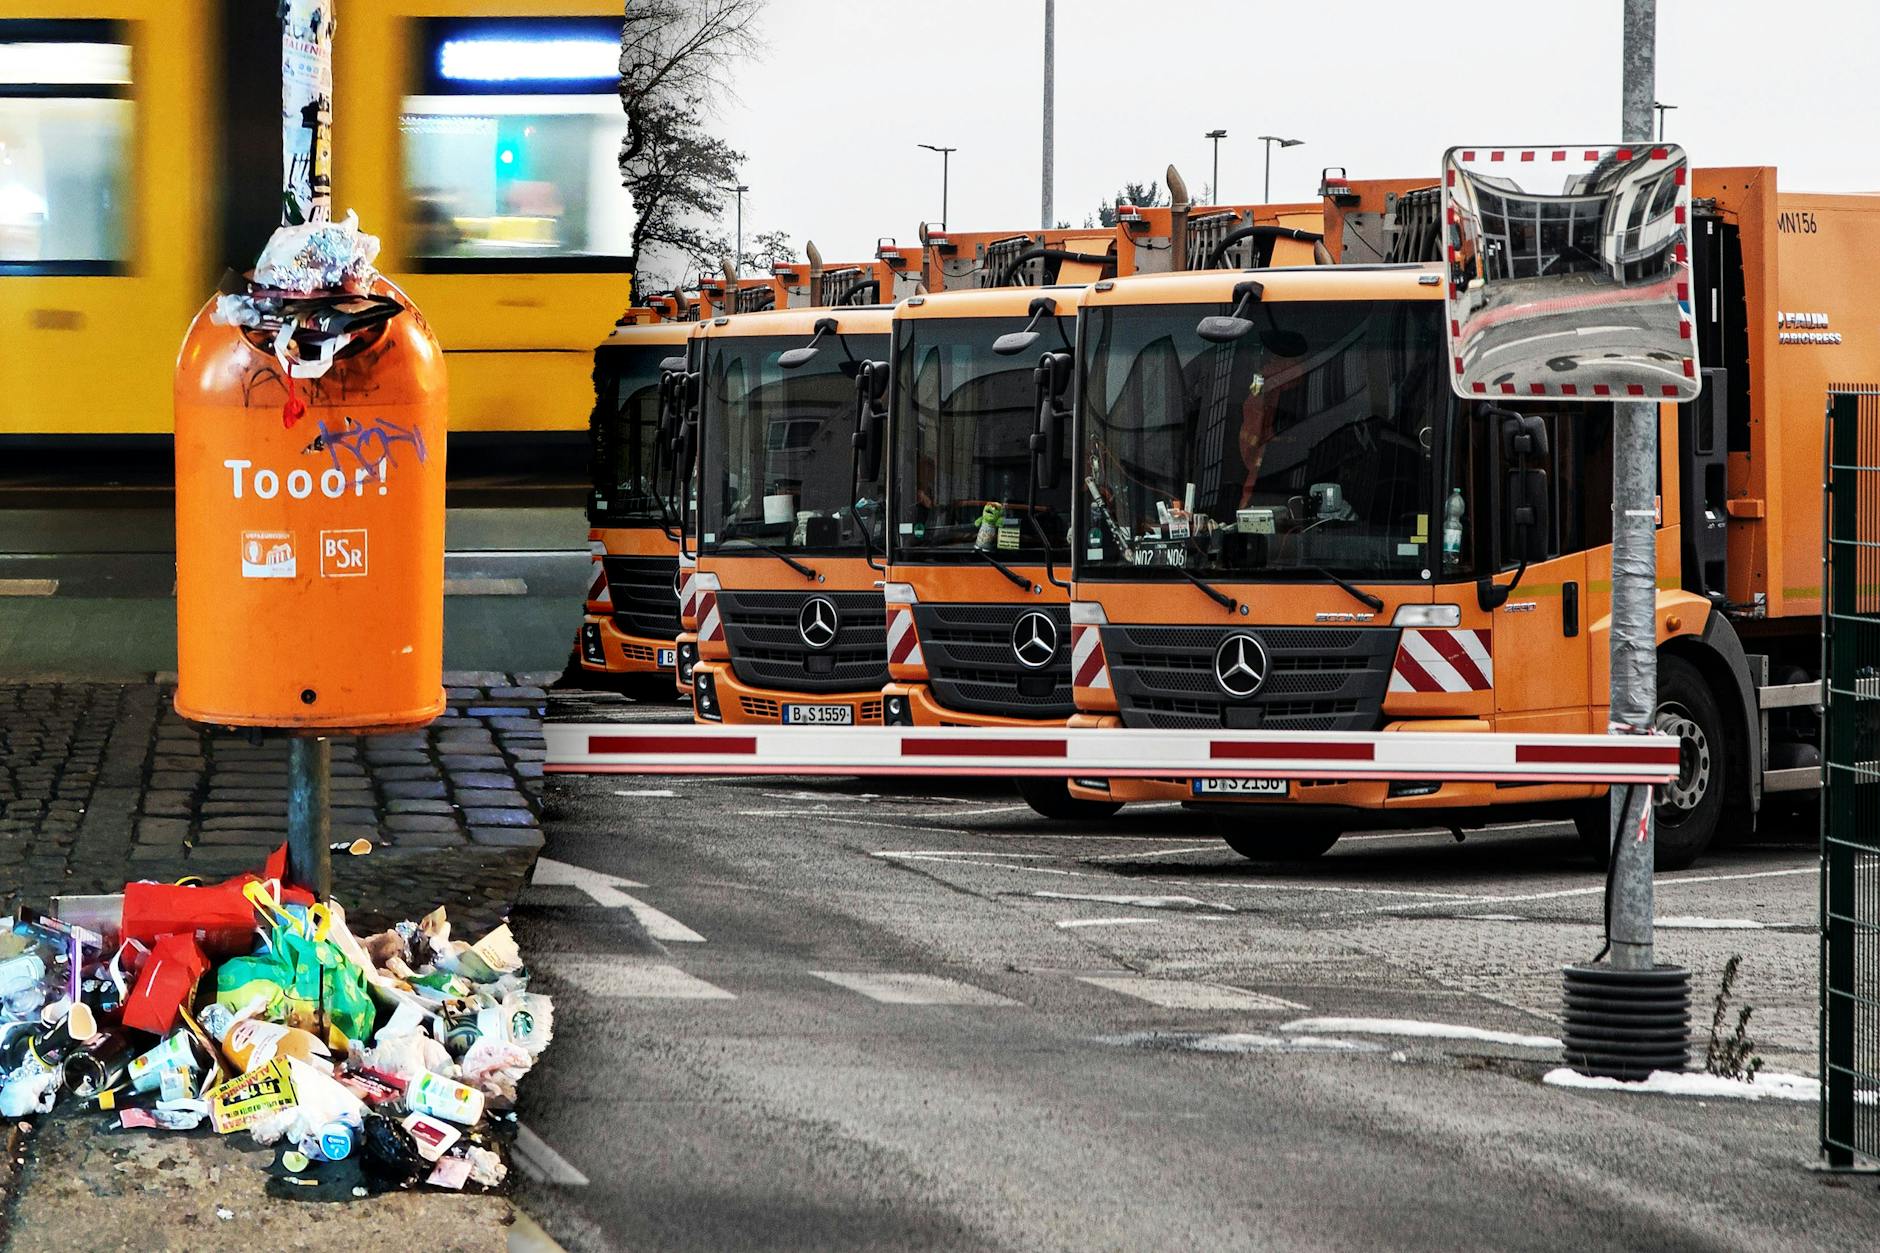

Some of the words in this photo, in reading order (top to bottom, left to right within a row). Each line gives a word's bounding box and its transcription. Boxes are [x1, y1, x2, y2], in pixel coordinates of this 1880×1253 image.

[1785, 312, 1829, 330] FAUN
[223, 459, 388, 499] Tooor!
[325, 539, 363, 568] BSR
[667, 651, 674, 663] B
[818, 707, 846, 722] 1559
